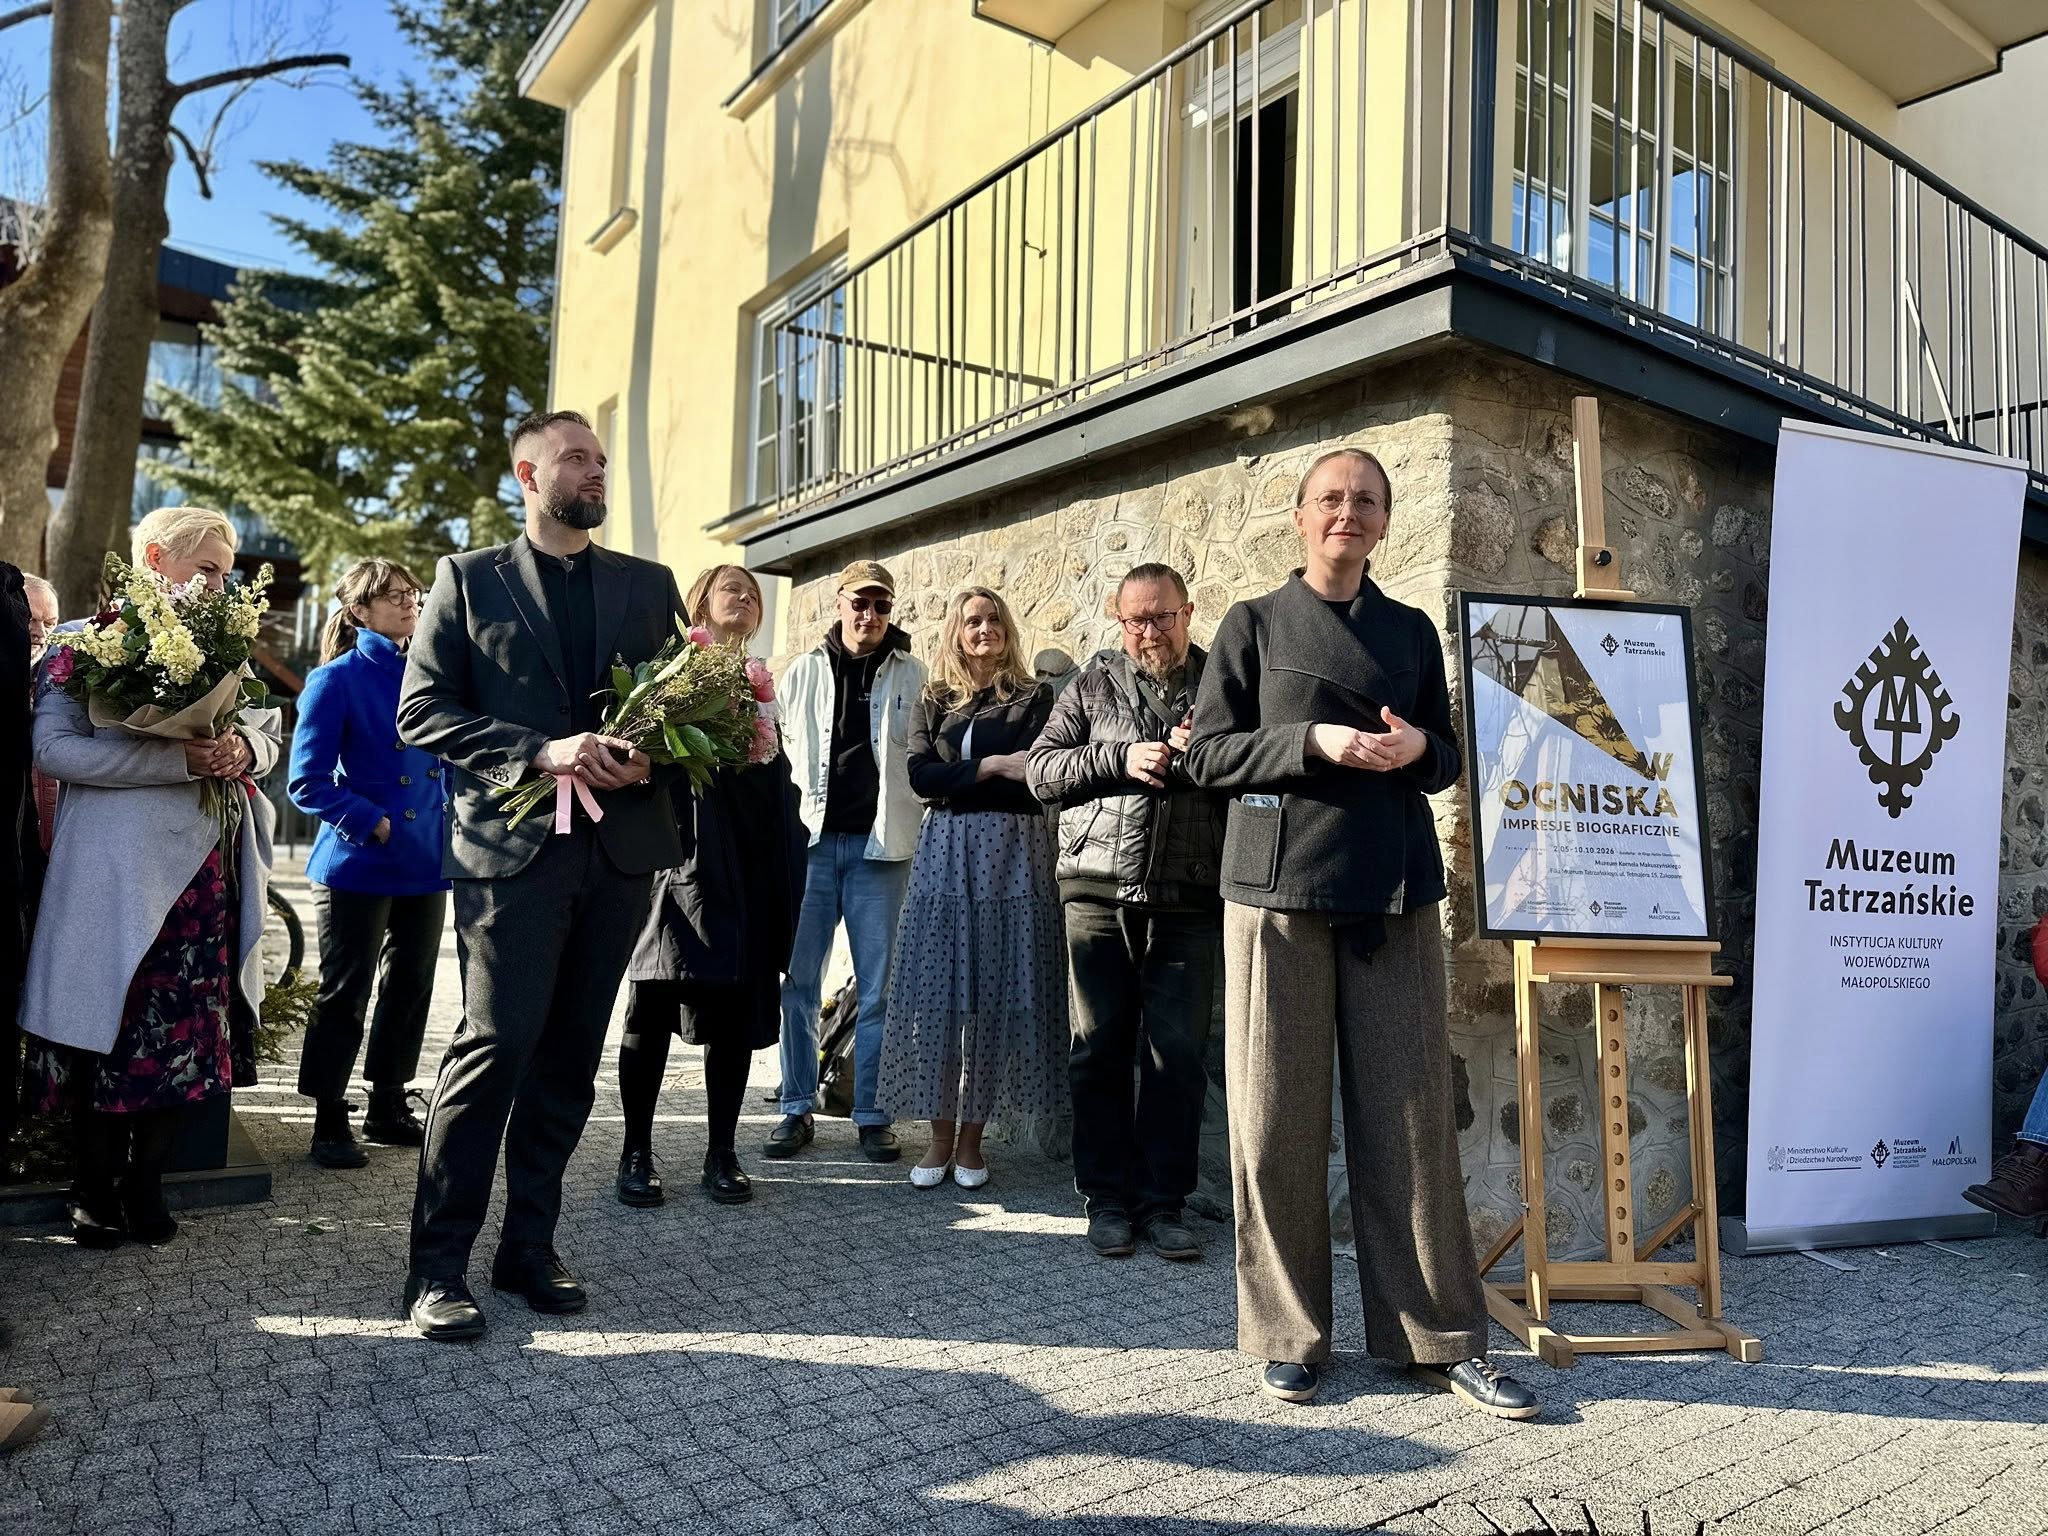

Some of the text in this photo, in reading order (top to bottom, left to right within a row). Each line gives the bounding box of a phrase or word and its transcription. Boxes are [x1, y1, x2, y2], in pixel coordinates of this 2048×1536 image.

[1624, 639, 1656, 647] Muzeum
[1624, 647, 1666, 656] Tatrzańskie
[1501, 780, 1678, 818] OGNISKA
[1503, 818, 1680, 837] IMPRESJE BIOGRAFICZNE
[1825, 838, 1955, 875] Muzeum
[1804, 879, 1975, 917] Tatrzańskie
[1830, 935, 1943, 949] INSTYTUCJA KULTURY
[1843, 955, 1930, 969] WOJEWÓDZTWA
[1841, 976, 1931, 989] MAŁOPOLSKIEGO
[1826, 1146, 1848, 1154] Kultury
[1893, 1146, 1927, 1154] Tatrzańskie
[1789, 1156, 1825, 1164] Dziedzictwa
[1826, 1155, 1862, 1163] Narodowego
[1932, 1157, 1977, 1166] MAŁOPOLSKA
